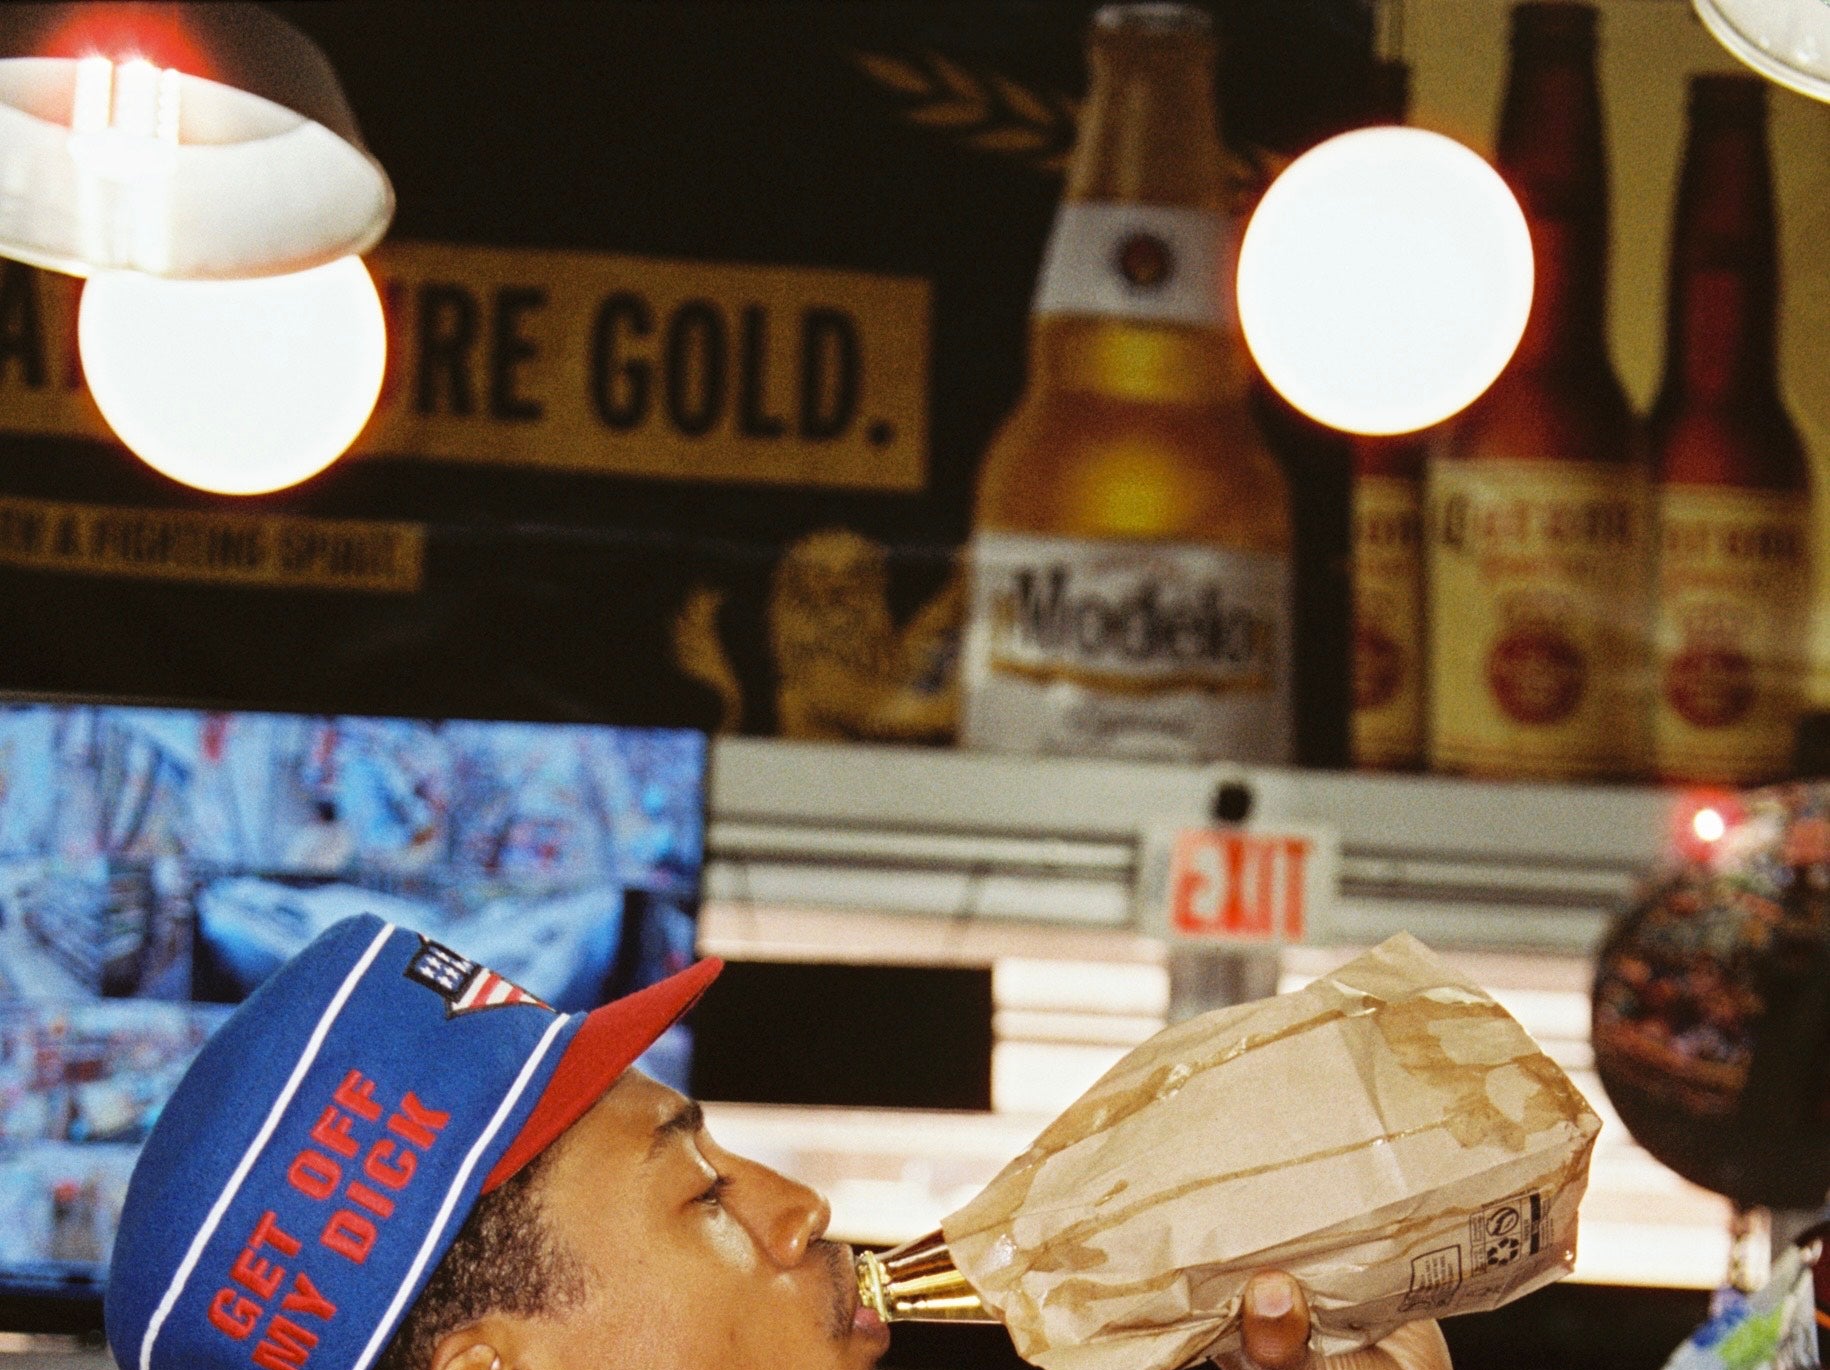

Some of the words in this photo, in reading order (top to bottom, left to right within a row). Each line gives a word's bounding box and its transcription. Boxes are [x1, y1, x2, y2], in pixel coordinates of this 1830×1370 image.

[588, 291, 896, 450] GOLD.
[1170, 830, 1316, 941] EXIT
[207, 1209, 303, 1341] GET
[287, 1068, 384, 1201] OFF
[319, 1090, 452, 1266] DICK
